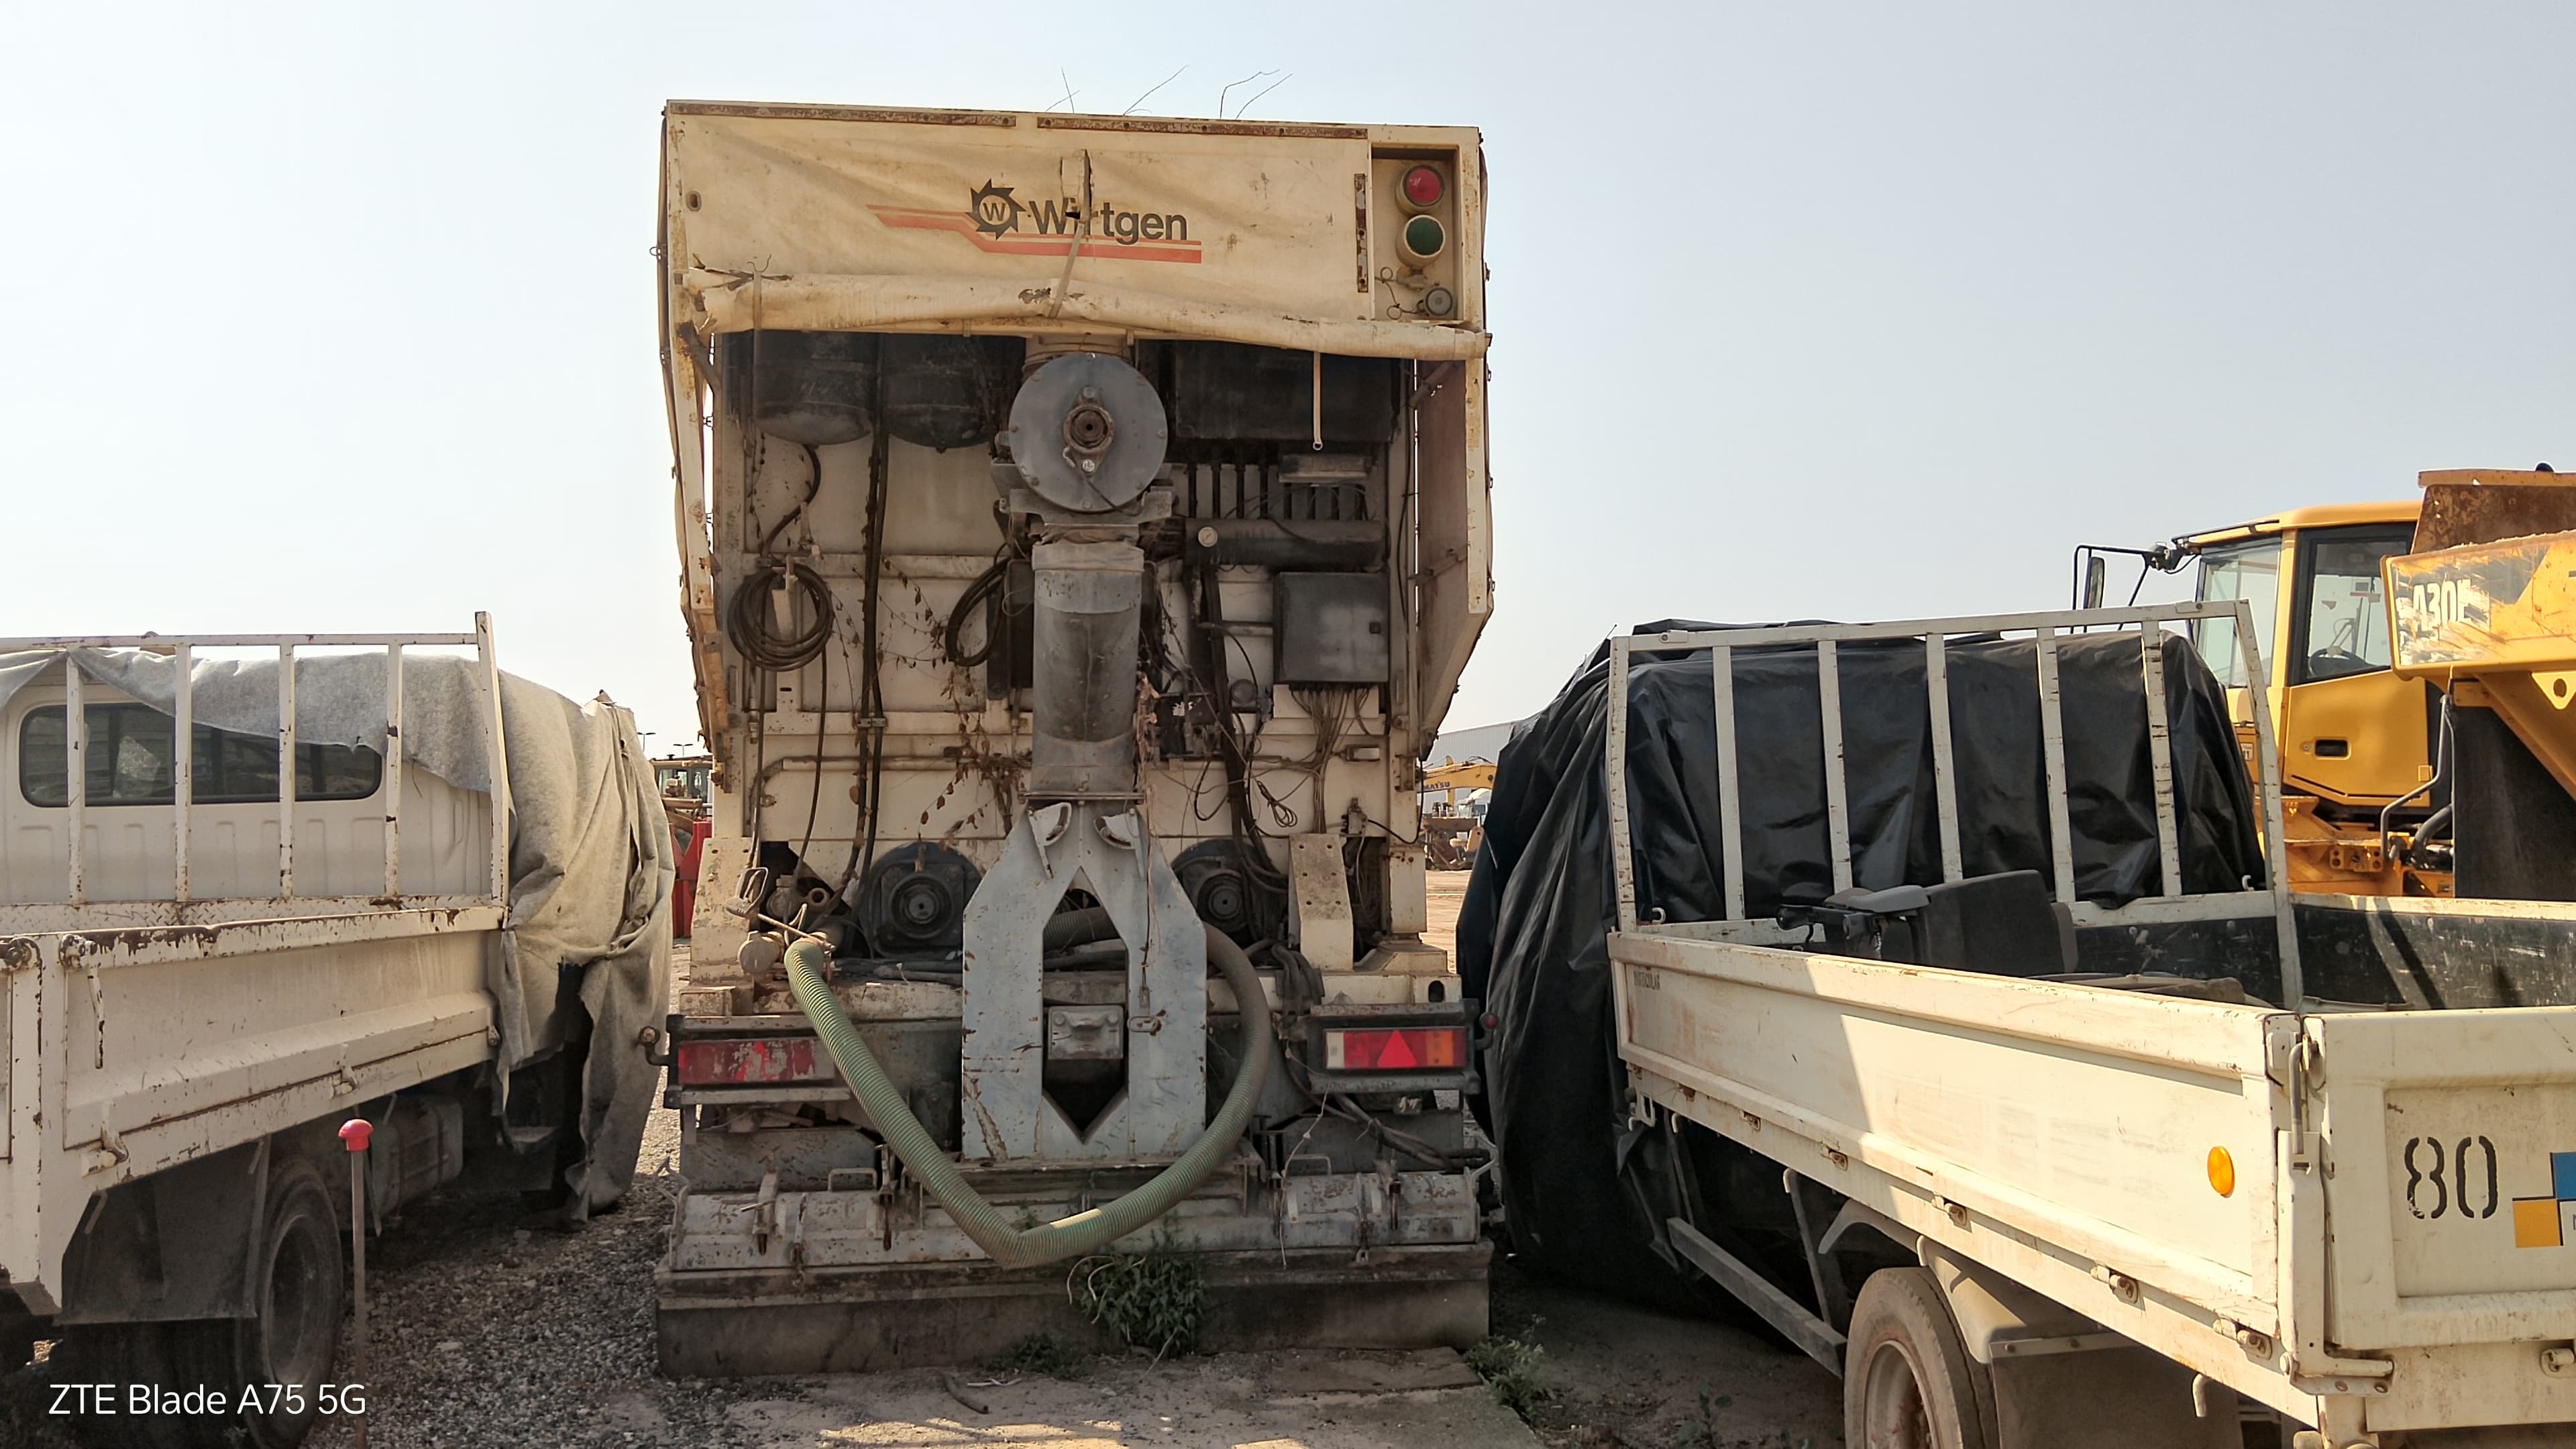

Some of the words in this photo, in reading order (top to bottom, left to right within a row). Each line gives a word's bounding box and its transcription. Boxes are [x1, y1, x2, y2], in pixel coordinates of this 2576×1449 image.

[983, 203, 1006, 221] W
[1423, 782, 1450, 790] MATSU
[2404, 1135, 2498, 1220] 80
